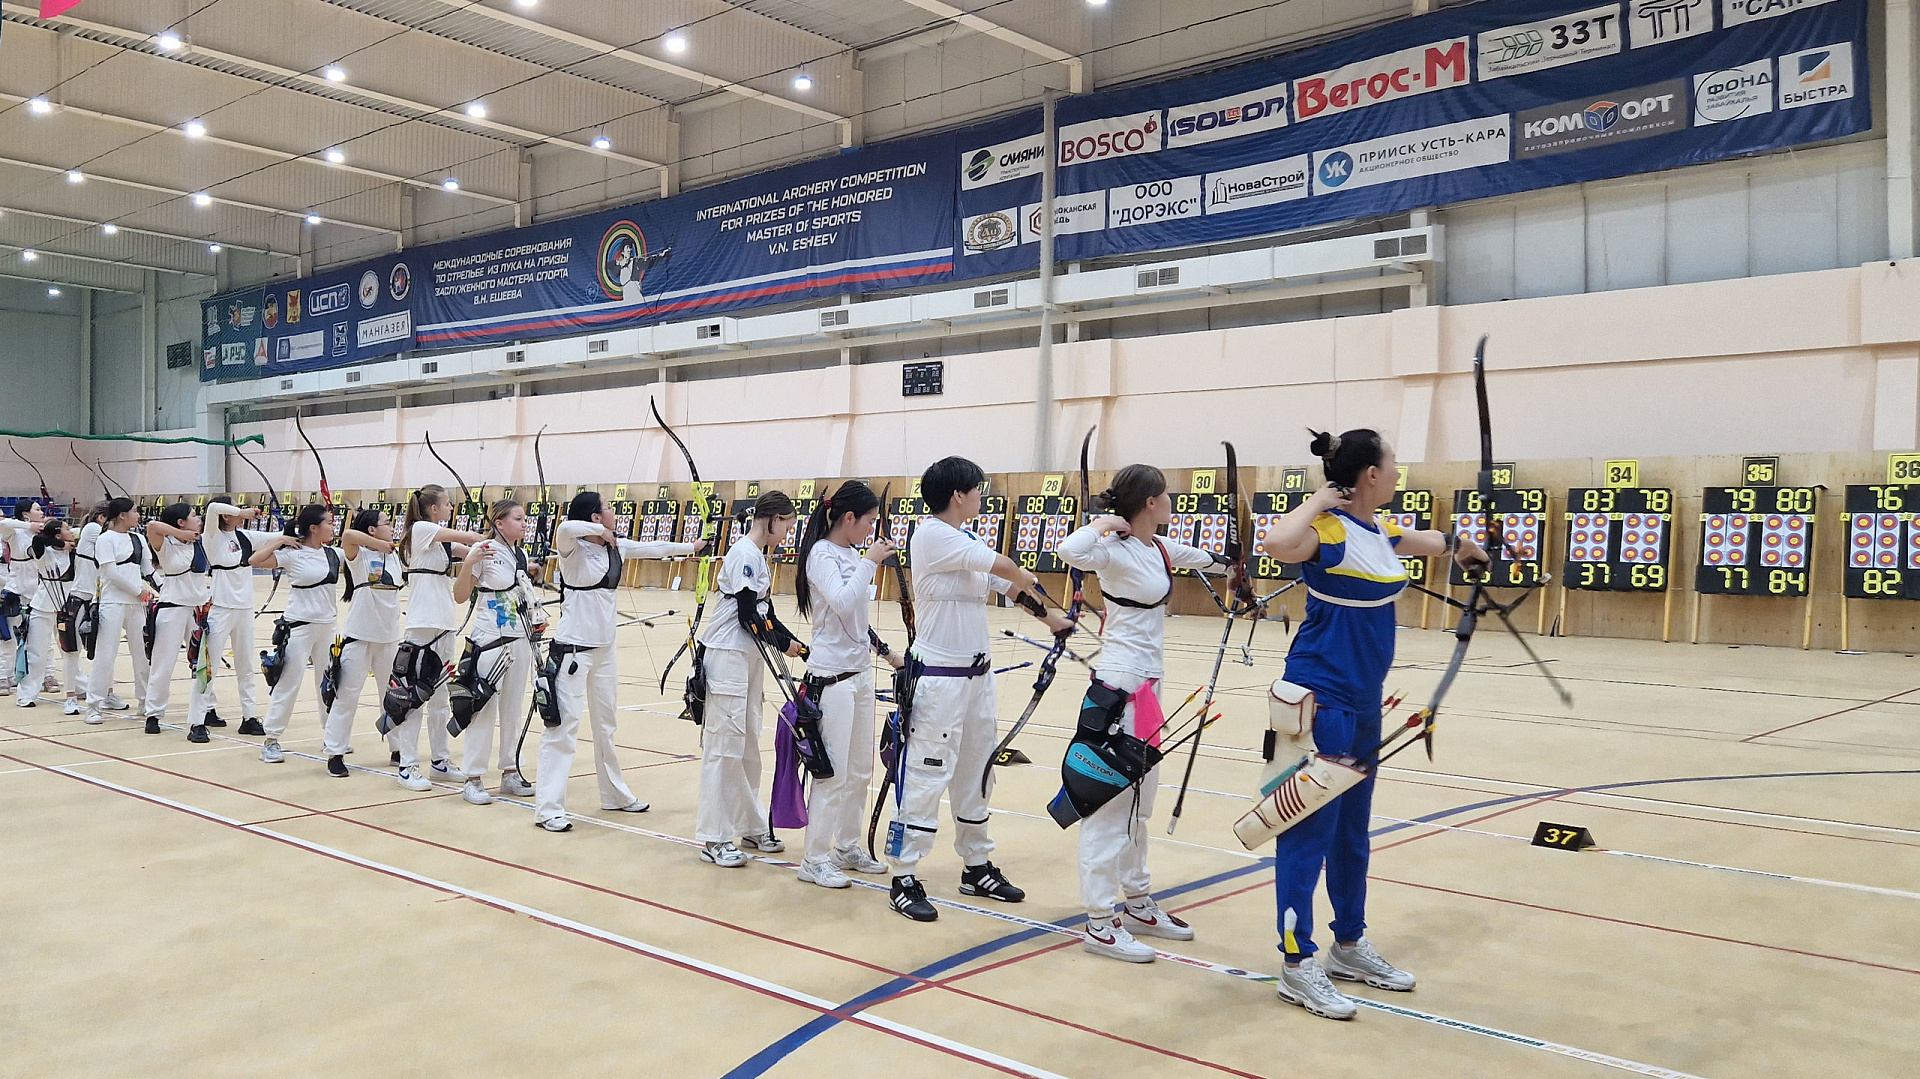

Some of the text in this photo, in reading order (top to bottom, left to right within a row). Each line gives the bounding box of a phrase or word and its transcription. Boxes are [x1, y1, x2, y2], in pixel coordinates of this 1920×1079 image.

[1297, 42, 1466, 119] Вегос-М
[1707, 72, 1772, 95] ФОНД
[1783, 84, 1848, 104] БЫСТРА
[1061, 128, 1145, 163] BOSCO
[1359, 127, 1506, 164] ПРИИСК УСТЬ-КАРА
[1000, 146, 1045, 167] СЛИЯНИ
[1359, 149, 1459, 174] АКЦИОНЕРНОЕ ОБЩЕСТВО
[696, 162, 927, 222] INTERNATIONAL ARCHERY COMPETITION
[1135, 181, 1173, 199] ООО
[1228, 170, 1305, 193] НоваСтрой
[720, 187, 893, 232] FOR PRIZES OF THE HONORED
[1054, 203, 1097, 215] ОКАНСКАЯ
[1112, 198, 1198, 224] "ДОРЭКС"
[746, 210, 862, 243] MASTER OF SPORTS
[433, 238, 572, 270] МЕЖДУНАРОДНЫЕ СОРЕВНОВАНИЯ
[768, 232, 838, 255] V.N. ESHEEV
[436, 253, 569, 283] ПО СТРЕЛЬБЕ ИЗ ЛУКА НА ПРИЗЫ
[434, 268, 569, 297] ЗАСЛУЖЕННОГО МАСТЕРА СПОРТА
[489, 289, 523, 303] ЕШЕЕВА
[361, 321, 406, 339] МАНГАЗЕЯ
[1610, 466, 1633, 483] 34
[1747, 464, 1773, 482] 35
[1895, 460, 1920, 478] 36
[802, 485, 812, 495] 24
[1045, 480, 1058, 491] 28
[1196, 476, 1210, 489] 30
[1285, 474, 1302, 489] 31
[617, 488, 627, 498] 20
[660, 487, 668, 498] 21
[1267, 493, 1288, 512] 78
[1402, 491, 1429, 512] 80
[1516, 490, 1543, 511] 79
[1583, 490, 1614, 512] 83
[1639, 489, 1668, 512] 78
[1724, 488, 1756, 512] 79
[1776, 488, 1812, 512] 80
[1868, 486, 1903, 511] 76
[622, 501, 633, 514] 85
[899, 498, 914, 514] 86
[986, 497, 1003, 513] 57
[1026, 497, 1044, 513] 88
[1176, 494, 1198, 513] 83
[1229, 514, 1238, 545] HOYT
[1020, 552, 1037, 569] 58
[1258, 556, 1282, 577] 85
[1580, 563, 1610, 585] 37
[1631, 564, 1664, 588] 69
[1717, 567, 1748, 589] 77
[1768, 569, 1805, 594] 84
[1863, 569, 1901, 595] 82
[996, 751, 1012, 763] 5
[1082, 758, 1114, 777] EASTON
[1543, 828, 1577, 845] 37
